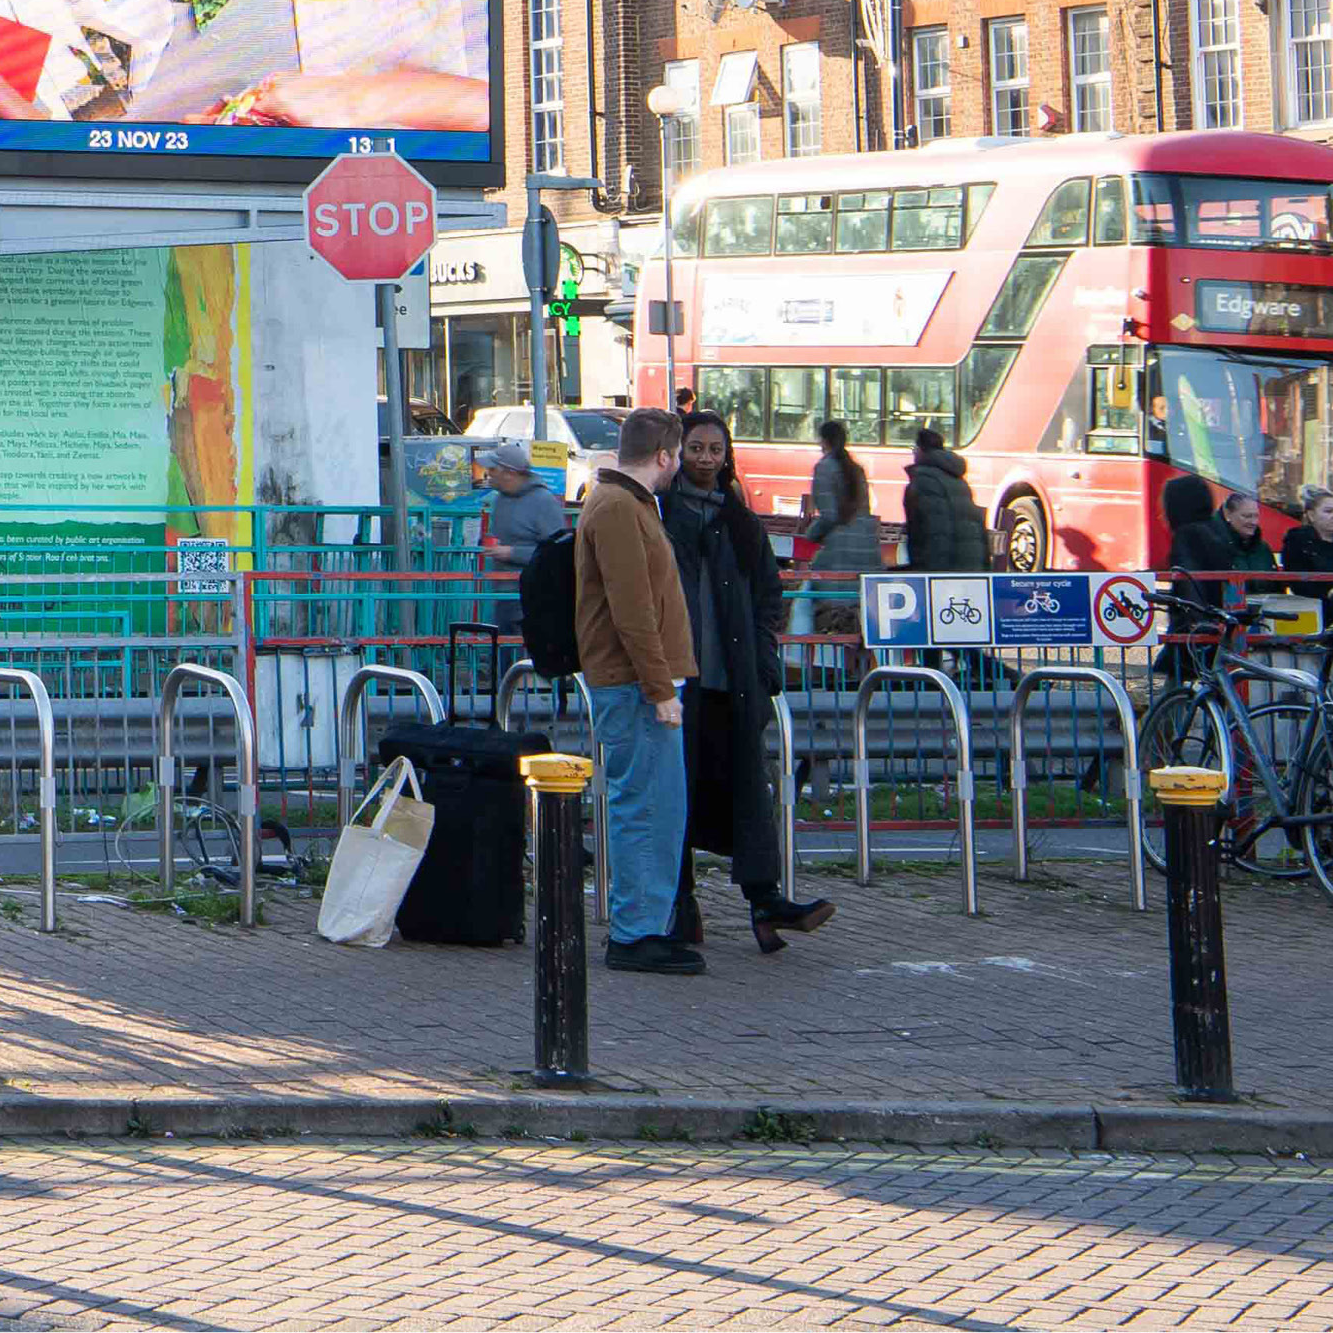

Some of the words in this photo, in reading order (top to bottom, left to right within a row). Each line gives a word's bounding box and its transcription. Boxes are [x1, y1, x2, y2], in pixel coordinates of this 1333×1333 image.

[89, 129, 113, 148] 23
[118, 130, 161, 149] NOV
[164, 132, 189, 150] 23
[314, 201, 428, 237] STOP
[1216, 293, 1301, 319] Edgware
[1036, 580, 1052, 589] your
[1053, 579, 1072, 589] cycle
[876, 582, 918, 640] P
